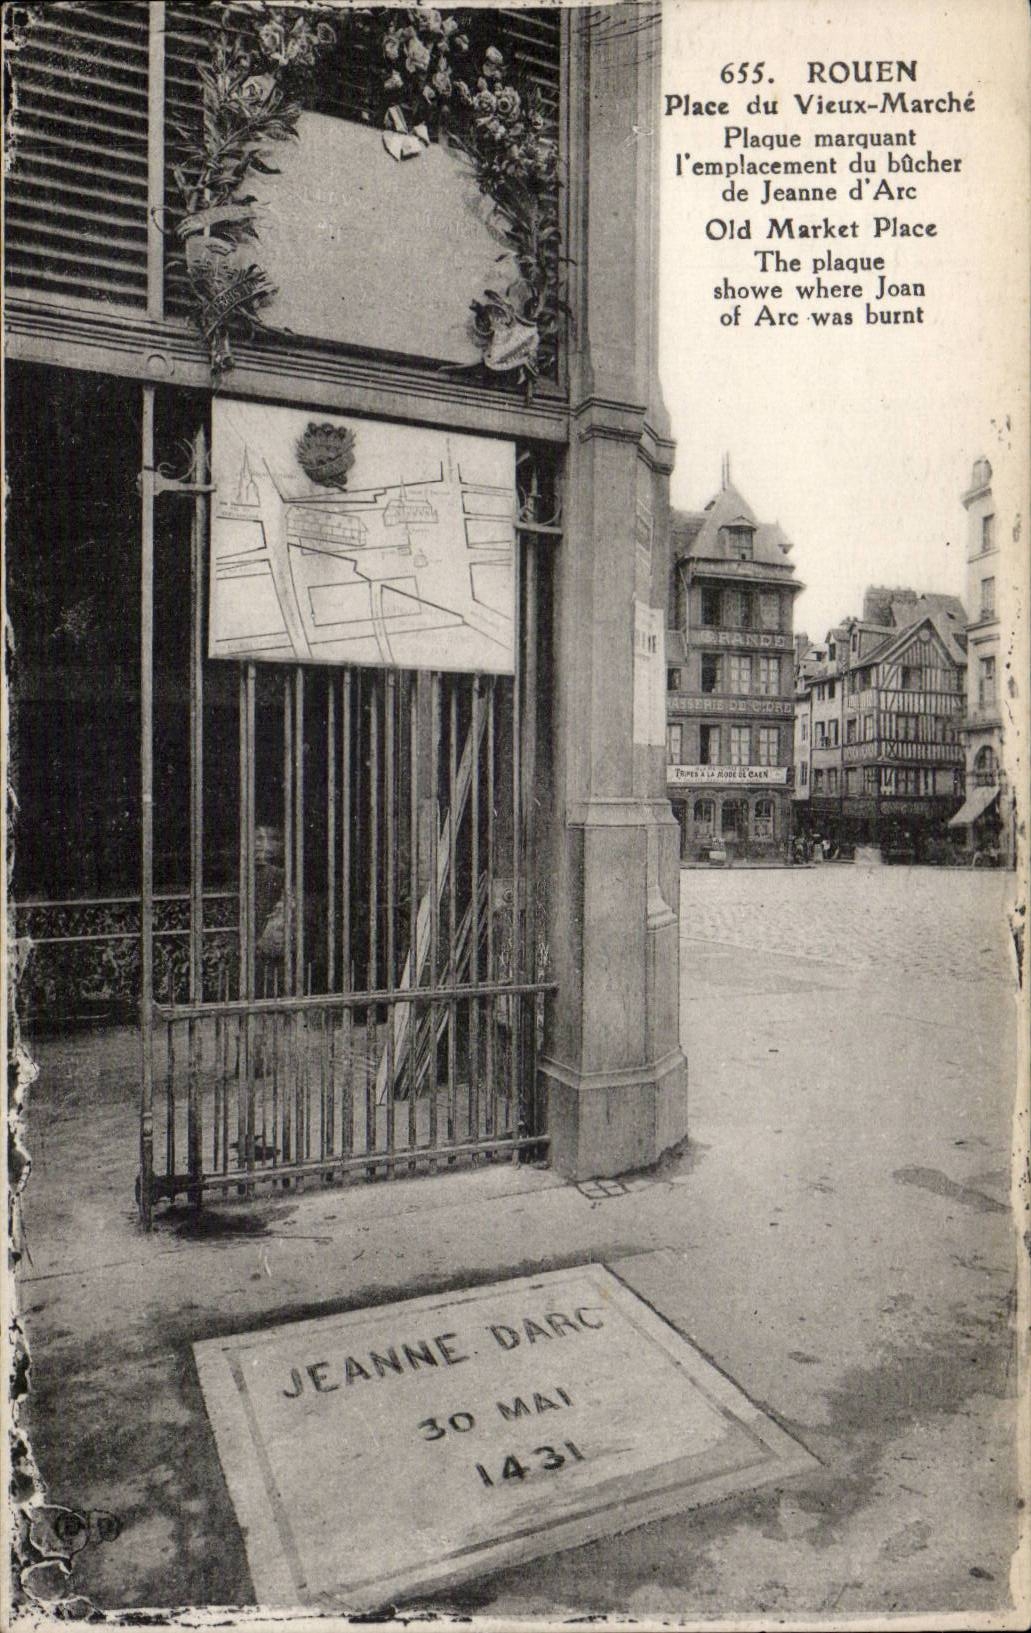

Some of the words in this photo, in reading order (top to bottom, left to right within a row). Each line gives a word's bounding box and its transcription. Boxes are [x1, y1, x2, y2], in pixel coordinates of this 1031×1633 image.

[701, 631, 785, 647] GRANDE
[730, 700, 746, 711] DE
[748, 769, 768, 778] CAEN
[282, 1333, 470, 1398] JEANNE
[486, 1307, 605, 1350] DARC
[417, 1412, 476, 1441] 30
[496, 1387, 573, 1421] MAI
[475, 1440, 586, 1487] 1431
